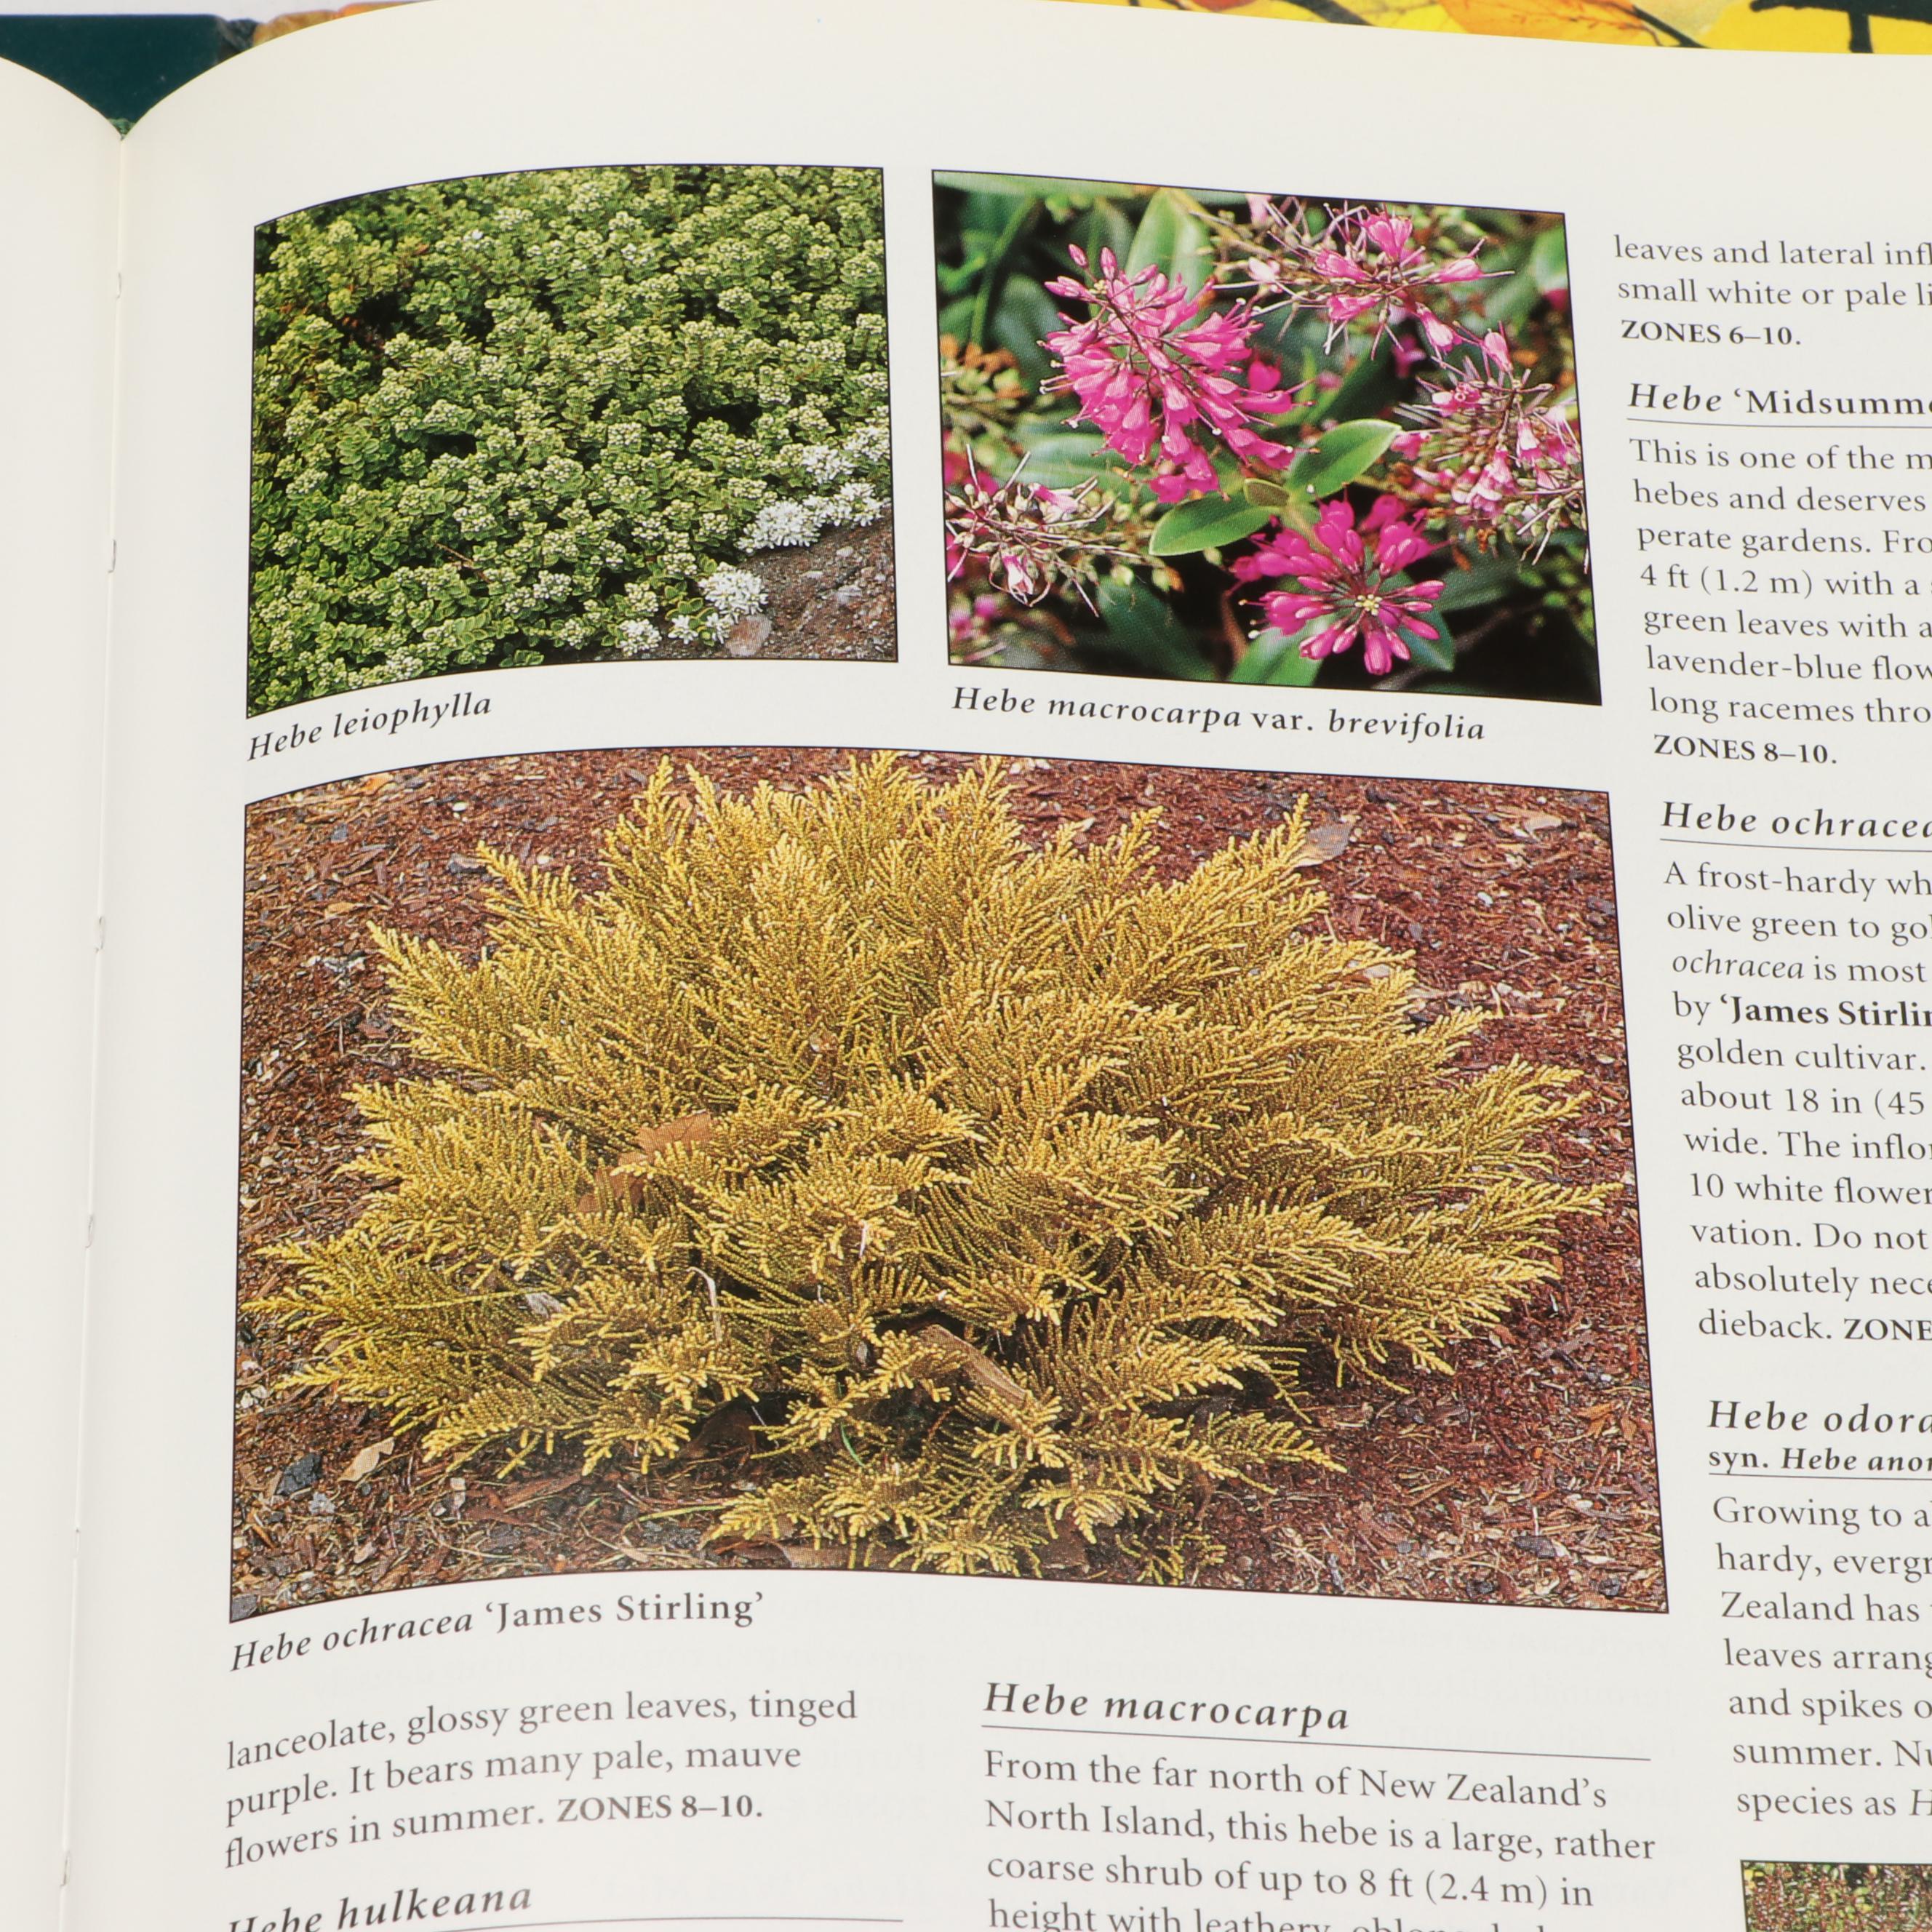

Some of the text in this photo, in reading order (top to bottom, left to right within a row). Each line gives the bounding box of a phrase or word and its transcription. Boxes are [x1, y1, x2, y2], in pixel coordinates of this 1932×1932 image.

[1613, 233, 1703, 263] leaves
[1713, 239, 1770, 264] and
[1779, 240, 1875, 265] lateral
[1618, 278, 1698, 303] small
[1707, 279, 1792, 305] white
[1802, 289, 1835, 305] or
[1845, 281, 1907, 313] pale
[1621, 319, 1722, 344] ZONES
[1627, 383, 1932, 415] Hebe ‘Midsumm
[1629, 438, 1697, 466] This
[1707, 442, 1730, 467] is
[1739, 452, 1796, 469] one
[1806, 444, 1840, 469] of
[1846, 444, 1895, 470] the
[1632, 478, 1926, 512] hebes and deserves
[1637, 527, 1932, 559] perate gardens. Fro
[1640, 564, 1657, 586] 4
[1666, 563, 1690, 589] ft
[1701, 566, 1758, 595] (1.2
[1769, 570, 1813, 599] m)
[1824, 570, 1894, 596] with
[1904, 579, 1920, 596] a
[1644, 611, 1728, 636] green
[1736, 609, 1829, 637] leaves
[1837, 612, 1908, 638] with
[1645, 644, 1862, 680] lavender-blue
[951, 686, 1485, 744] Hebe macrocarpa var. brevifolia
[1649, 686, 1931, 724] long racemes thro
[247, 691, 492, 762] Hebe leiophylla
[1653, 733, 1756, 761] ZONES
[1660, 801, 1757, 833] Hebe
[1663, 861, 1932, 903] A frost-hardy wh
[1666, 903, 1741, 933] olive
[1752, 917, 1838, 942] green
[1848, 917, 1880, 938] to
[1672, 948, 1927, 983] ochracea is most
[1672, 990, 1711, 1026] by
[1677, 1037, 1926, 1071] golden cultivar.
[1681, 1080, 1925, 1119] about 18 in (45
[1682, 1127, 1932, 1160] wide. The inflo
[1691, 1173, 1724, 1199] 10
[1733, 1173, 1823, 1203] white
[1689, 1218, 1929, 1250] vation. Do not
[1695, 1261, 1860, 1303] absolutely
[1699, 1307, 1932, 1341] dieback. ZONE
[1707, 1400, 1808, 1432] Hebe
[1709, 1447, 1932, 1474] syn. Hebe ano
[1712, 1496, 1861, 1536] Growing
[1869, 1504, 1902, 1528] to
[1715, 1541, 1822, 1581] hardy,
[1721, 1591, 1855, 1621] Zealand
[1863, 1593, 1920, 1623] has
[230, 1632, 311, 1672] Hebe
[322, 1613, 473, 1651] ochracea
[1723, 1637, 1822, 1669] leaves
[983, 1682, 1349, 1739] Hebe macrocarpa
[1729, 1687, 1792, 1716] and
[1802, 1689, 1903, 1726] spikes
[227, 1689, 858, 1770] lanceolate, glossy green leaves, tinged
[1733, 1744, 1882, 1767] summer.
[226, 1739, 801, 1828] purple. It bears many pale, mauve
[984, 1749, 1077, 1781] From
[1088, 1754, 1141, 1785] the
[1152, 1757, 1198, 1787] far
[1209, 1763, 1304, 1793] north
[1315, 1765, 1352, 1795] of
[1358, 1768, 1436, 1799] New
[1737, 1786, 1853, 1822] species
[1864, 1797, 1896, 1816] as
[225, 1827, 338, 1869] flowers
[349, 1815, 381, 1844] in
[392, 1805, 543, 1837] summer.
[556, 1795, 672, 1822] ZONES
[985, 1800, 1656, 1862] North Island, this hebe is a large, rather
[987, 1854, 1594, 1910] coarse shrub of up to 8 ft (2.4 m) in
[337, 1887, 531, 1931] hulkeana
[989, 1898, 1097, 1932] height
[1107, 1906, 1181, 1932] with
